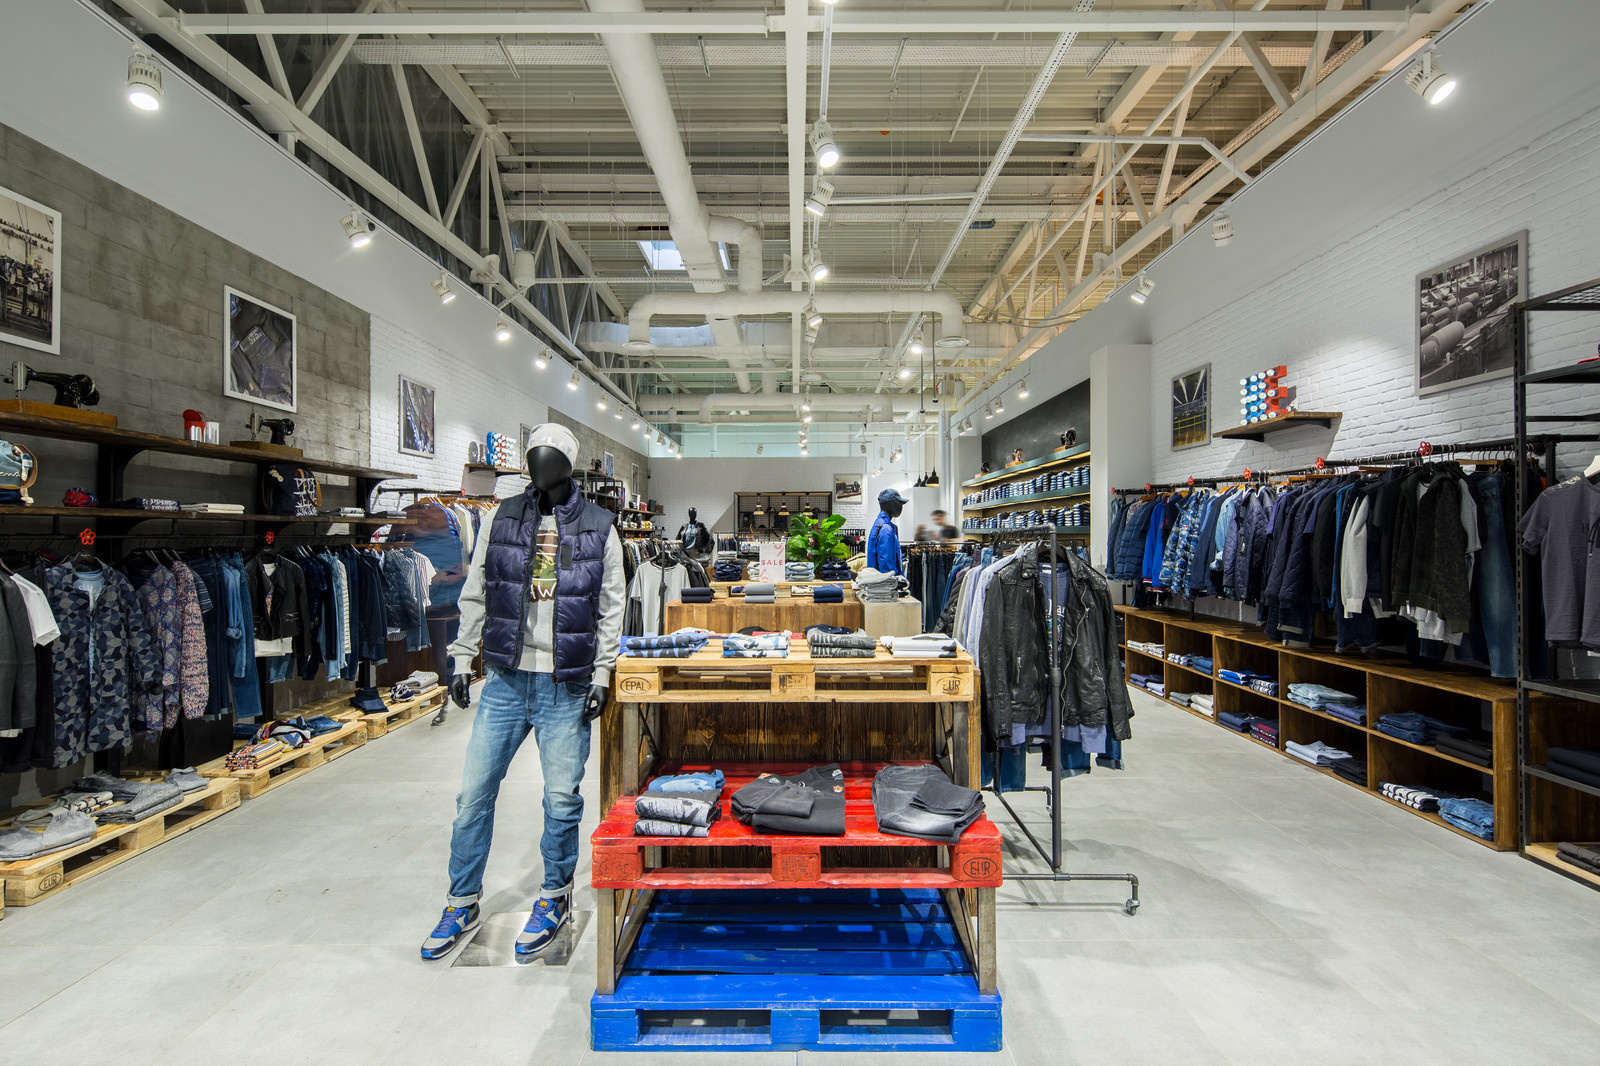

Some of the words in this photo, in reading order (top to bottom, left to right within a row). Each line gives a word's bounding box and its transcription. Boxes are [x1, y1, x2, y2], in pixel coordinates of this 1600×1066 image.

[625, 681, 647, 691] EPAL
[970, 861, 991, 876] EUR
[43, 875, 58, 889] EUR
